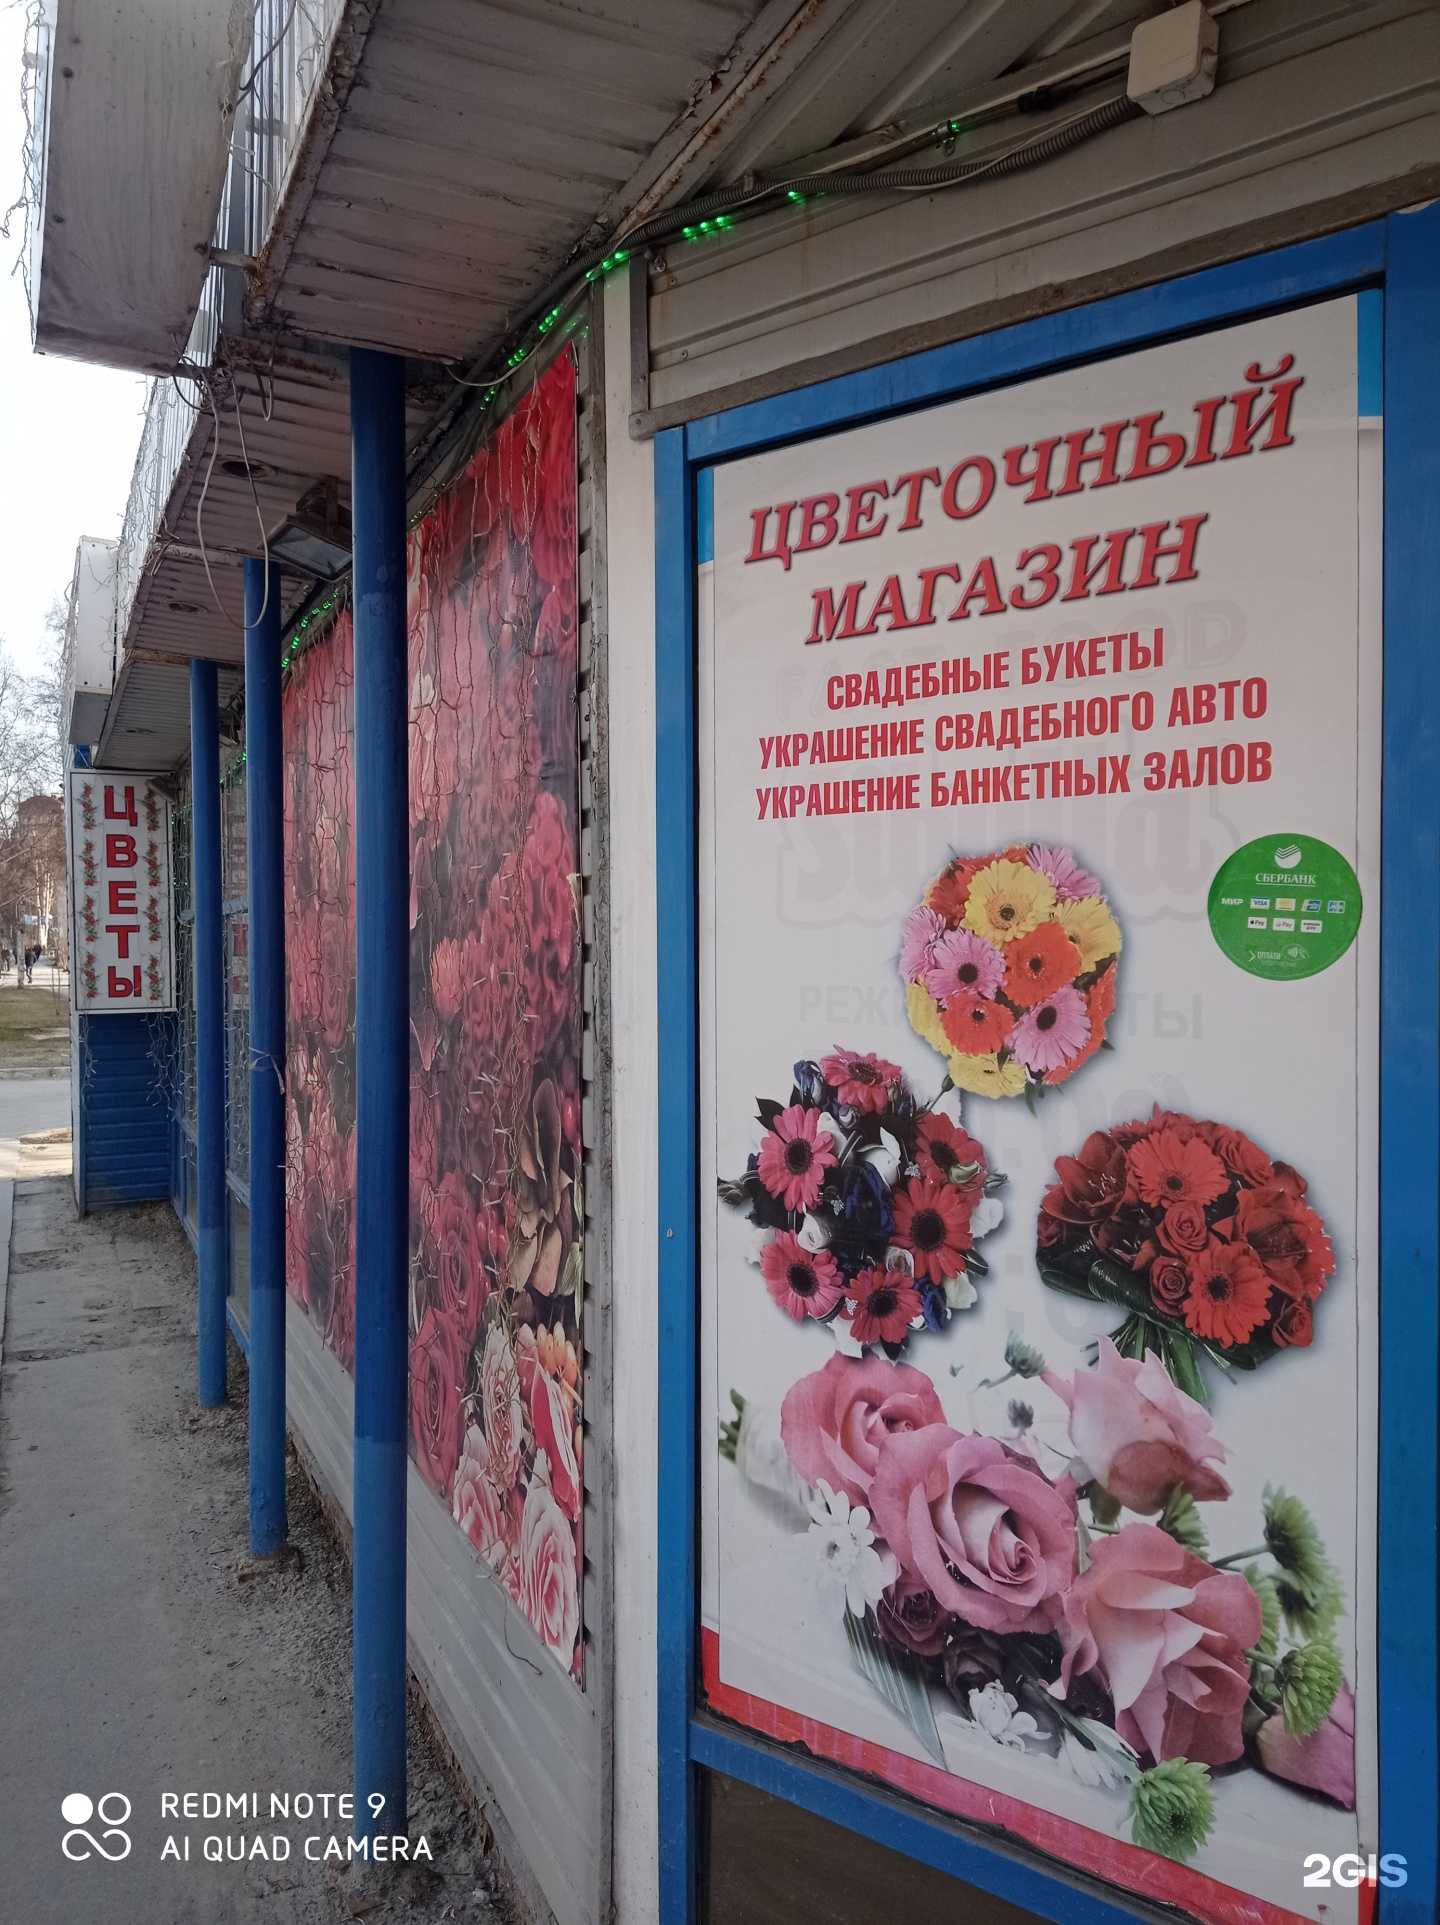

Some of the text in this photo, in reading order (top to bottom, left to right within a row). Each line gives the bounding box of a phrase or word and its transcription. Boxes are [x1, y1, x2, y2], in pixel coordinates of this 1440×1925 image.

[743, 353, 1305, 571] ЦВЕТОЧНЫЙ
[804, 512, 1208, 645] МАГАЗИН
[826, 652, 1010, 711] СВАДЕБНЫЕ
[1020, 628, 1165, 686] БУКЕТЫ
[758, 677, 1268, 770] УКРАШЕНИЕ СВАДЕБНОГО АВТО
[756, 741, 1273, 821] УКРАШЕНИЕ БАНКЕТНЫХ ЗАЛОВ
[104, 785, 142, 998] ЦВЕТЫ
[1255, 872, 1317, 885] СБЕРБАНК
